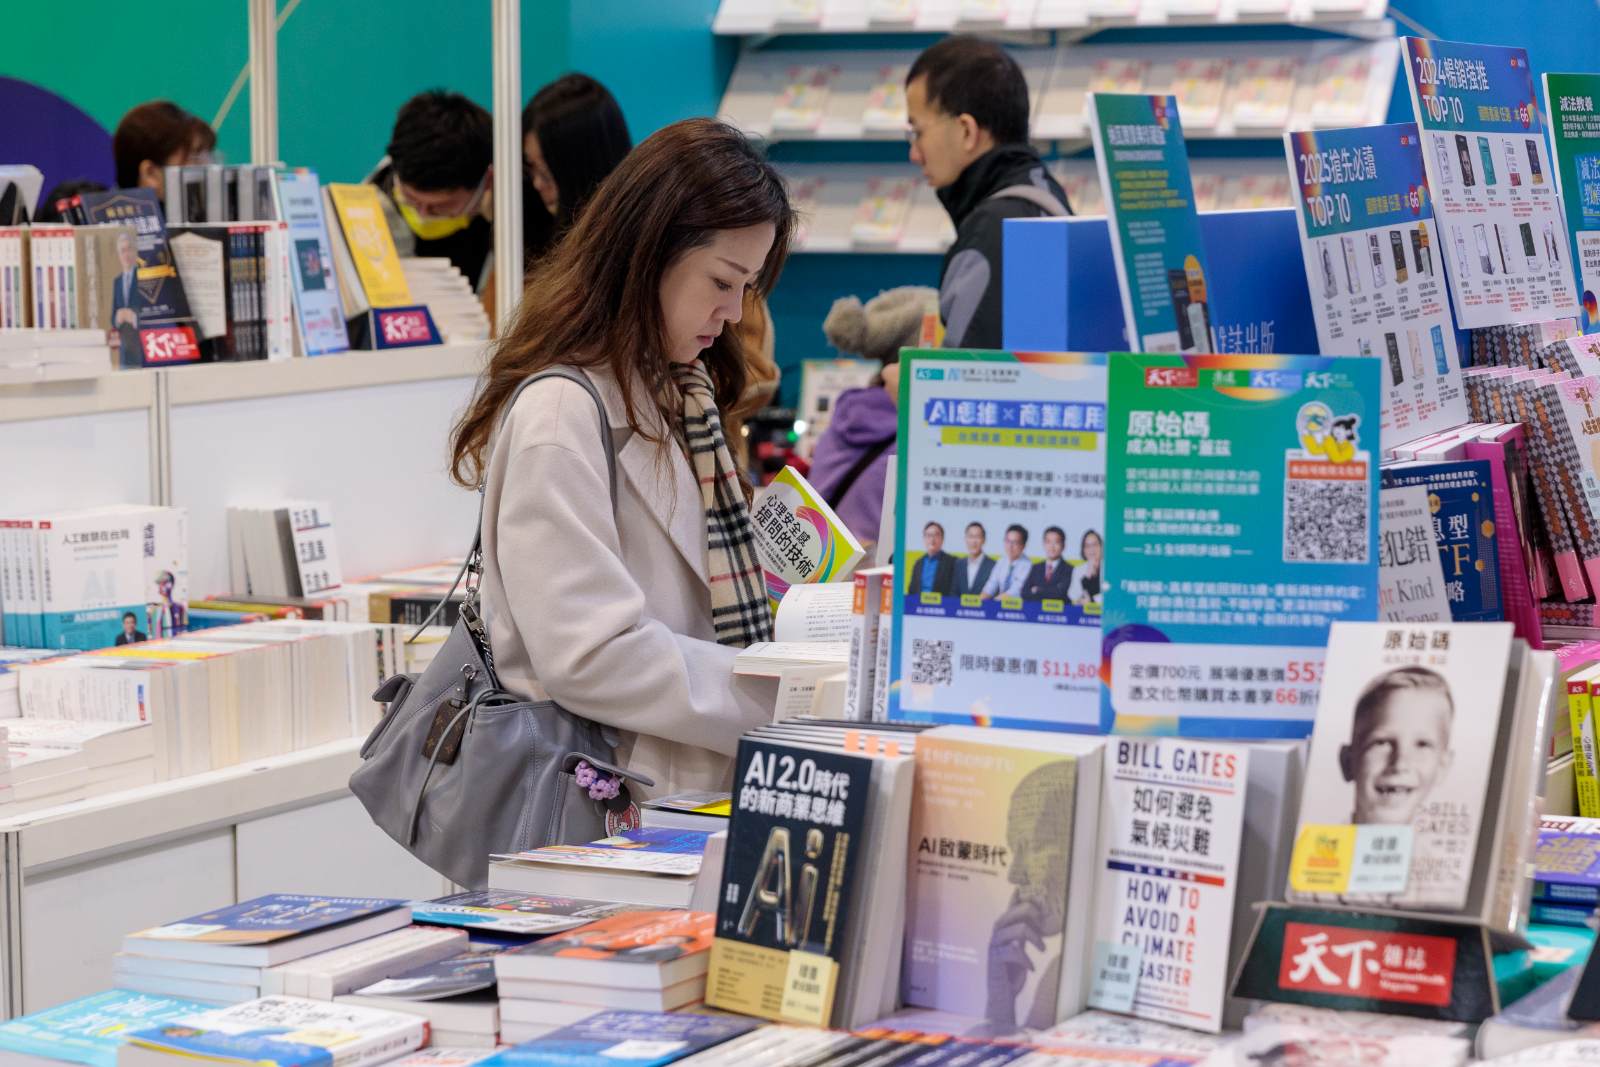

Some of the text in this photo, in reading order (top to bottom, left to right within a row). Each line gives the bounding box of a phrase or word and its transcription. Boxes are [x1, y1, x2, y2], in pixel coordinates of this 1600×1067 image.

[1423, 94, 1464, 124] TOP 10
[1307, 192, 1351, 228] TOP 10
[1126, 410, 1210, 438] 原始碼
[766, 493, 811, 547] 心理安全感
[754, 505, 815, 579] 提問的技術
[1395, 576, 1435, 604] Kind
[1383, 630, 1451, 650] 原始碼
[960, 653, 1037, 676] 限時優惠價
[1117, 741, 1163, 770] BILL
[1173, 748, 1237, 779] GATES
[738, 784, 847, 827] 的新商業思維
[1132, 786, 1213, 824] 如何避免
[1129, 819, 1211, 857] 氣候災難
[1127, 877, 1200, 911] HOW TO
[1123, 906, 1197, 937] AVOID A
